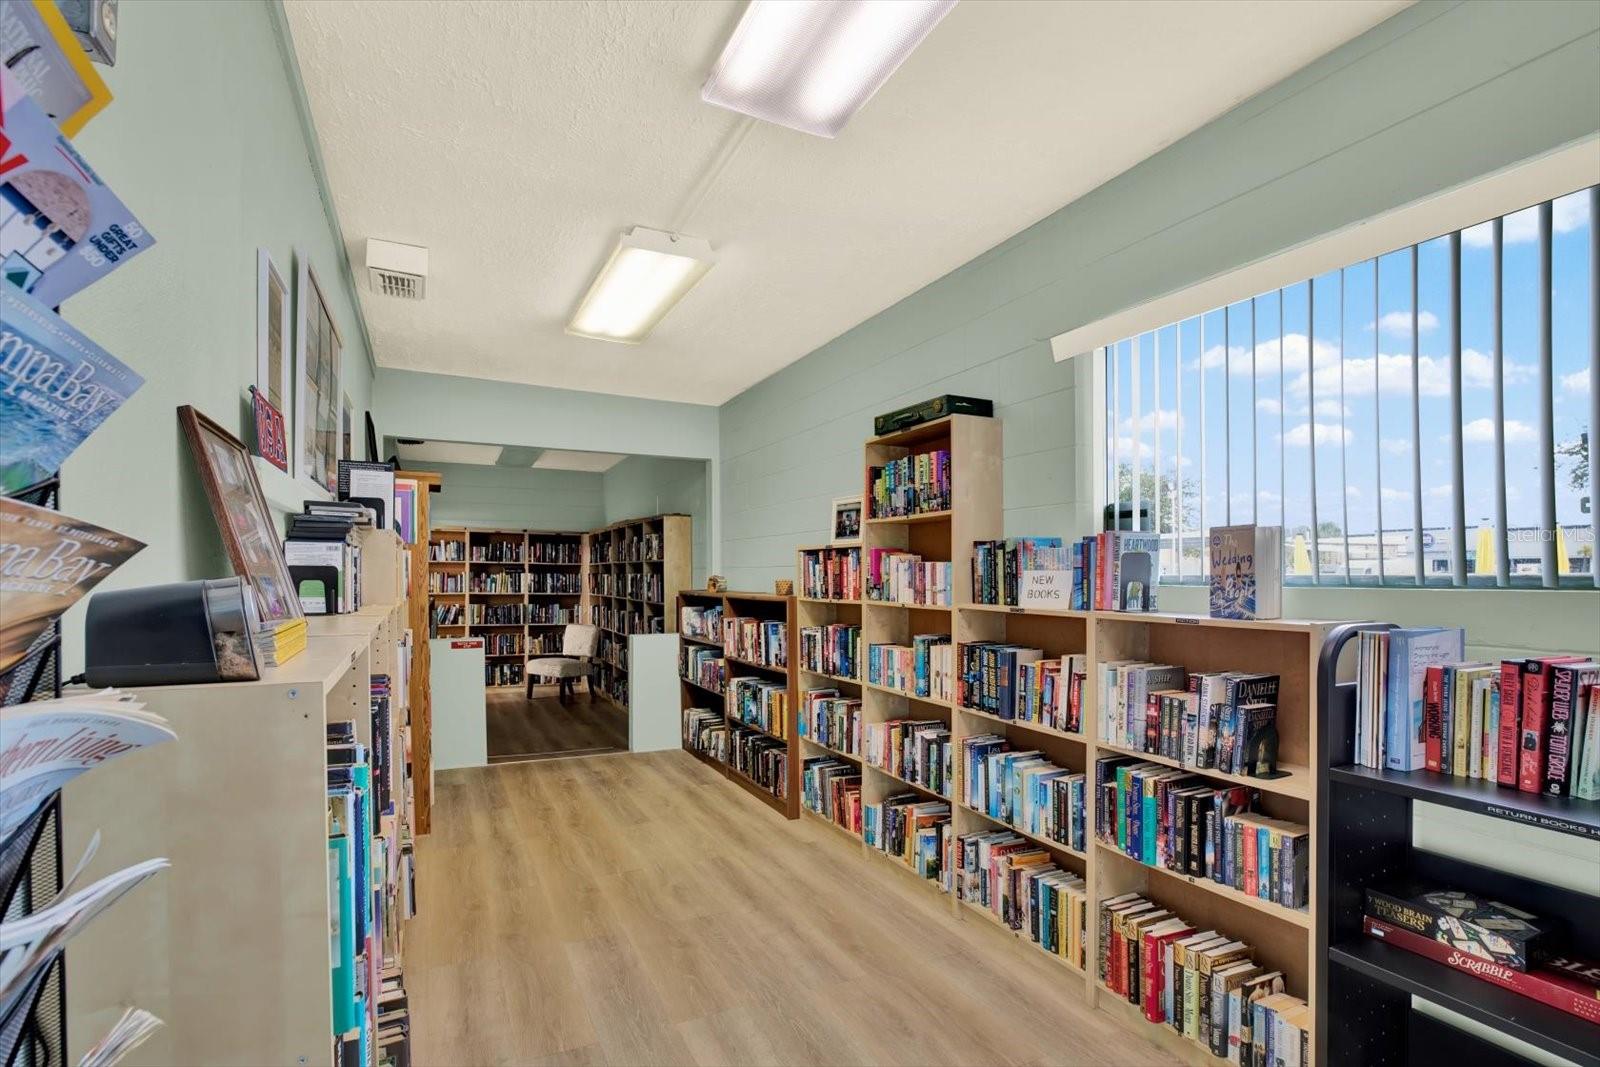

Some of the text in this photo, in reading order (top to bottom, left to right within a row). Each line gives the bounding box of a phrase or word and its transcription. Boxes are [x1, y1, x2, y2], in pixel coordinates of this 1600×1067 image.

[101, 231, 127, 257] GIFTS
[109, 223, 138, 251] GREAT
[123, 221, 143, 239] 50
[89, 235, 120, 264] UNDER
[19, 389, 72, 420] MAGAZINE
[51, 359, 115, 427] Bay
[1123, 538, 1159, 552] HEARTWOOD
[1211, 548, 1253, 570] Wedding
[24, 538, 112, 596] Bay
[1031, 575, 1055, 585] NEW
[1027, 589, 1061, 600] BOOKS
[988, 668, 996, 698] SANDFORD
[1238, 681, 1278, 698] DANIELLE
[1552, 669, 1572, 720] SPYDER WEB
[1427, 702, 1440, 739] WORKING
[1547, 734, 1568, 782] TOM GRACE
[1487, 806, 1537, 822] RETURN
[1540, 818, 1586, 834] BOOKS
[1374, 896, 1402, 913] WOOD
[1403, 908, 1433, 924] BRAIN
[1376, 904, 1426, 931] TEASERS
[1448, 952, 1513, 981] SCRABBLE
